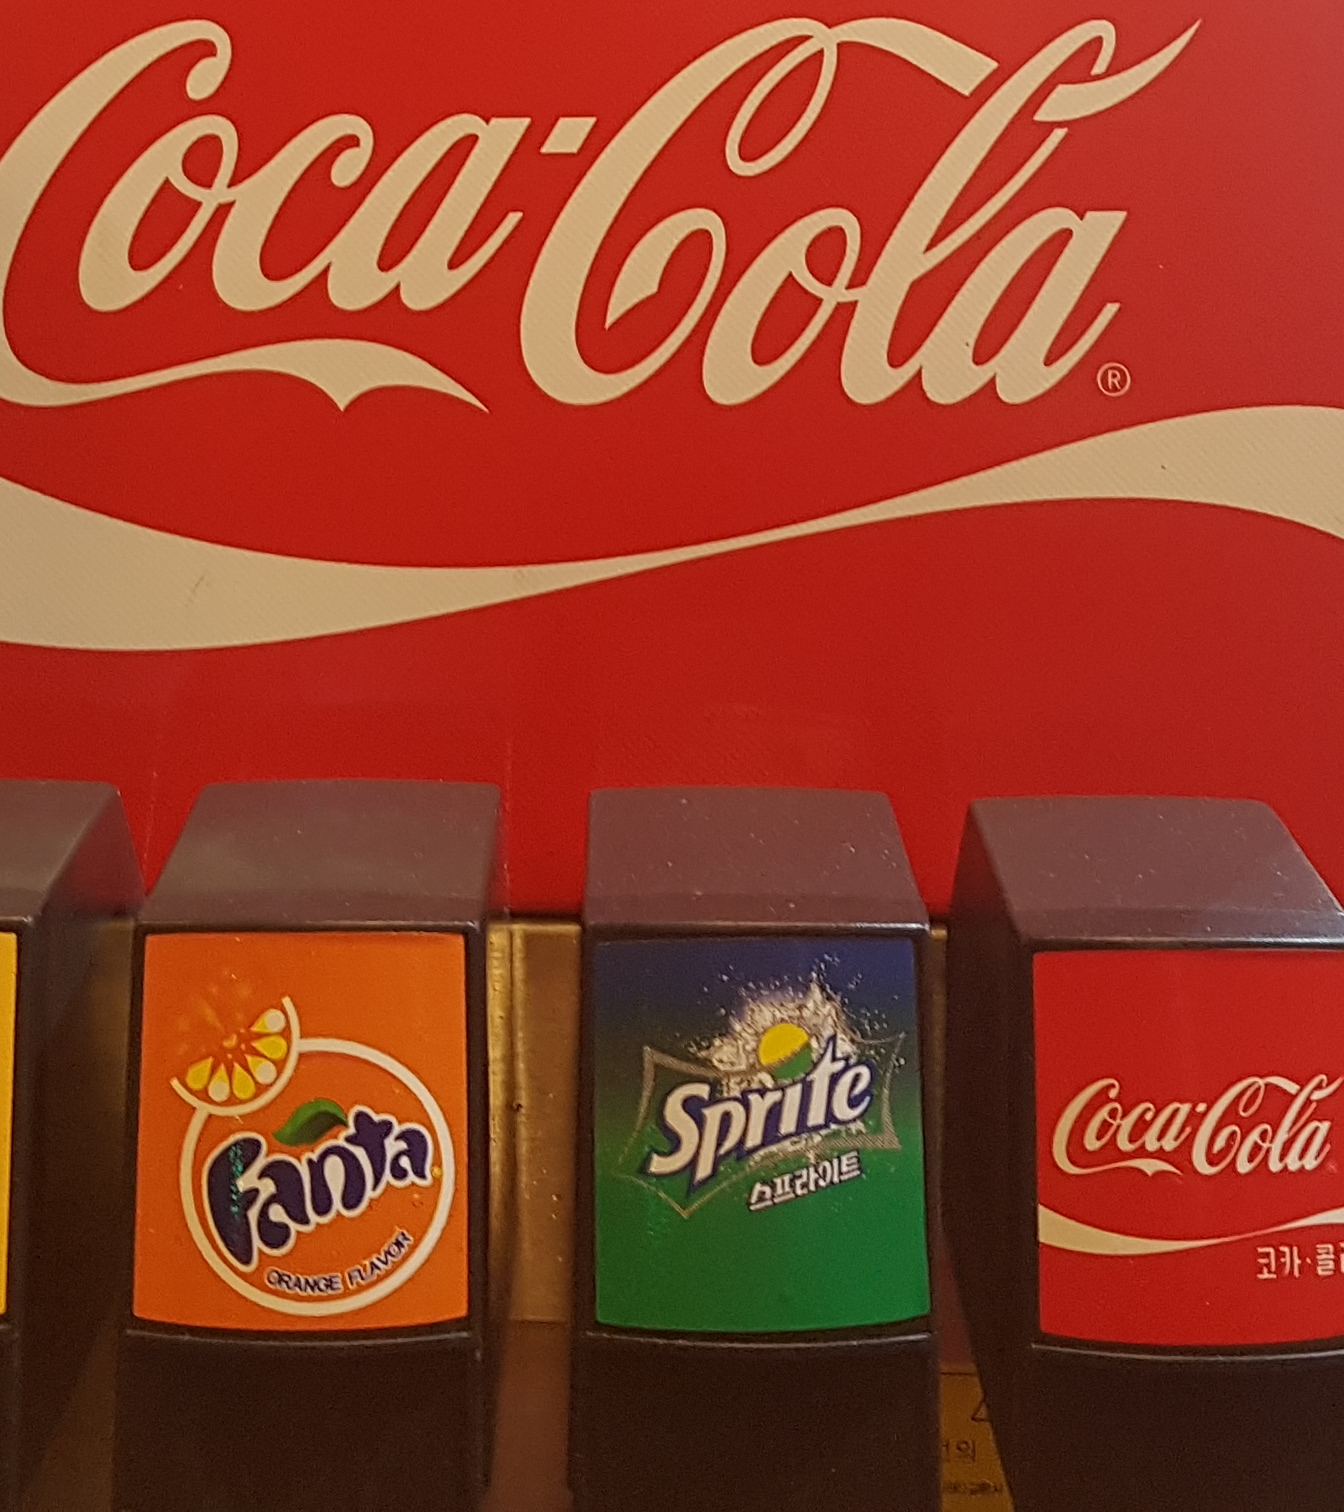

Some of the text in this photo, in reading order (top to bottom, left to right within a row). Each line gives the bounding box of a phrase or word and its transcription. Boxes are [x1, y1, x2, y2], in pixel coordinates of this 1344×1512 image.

[647, 1036, 874, 1189] Sprite
[1053, 1074, 1344, 1175] Coca-Cola
[203, 1109, 433, 1271] Fanta
[747, 1150, 862, 1212] 스프라이트
[265, 1230, 412, 1295] ORANGE FLAVOR
